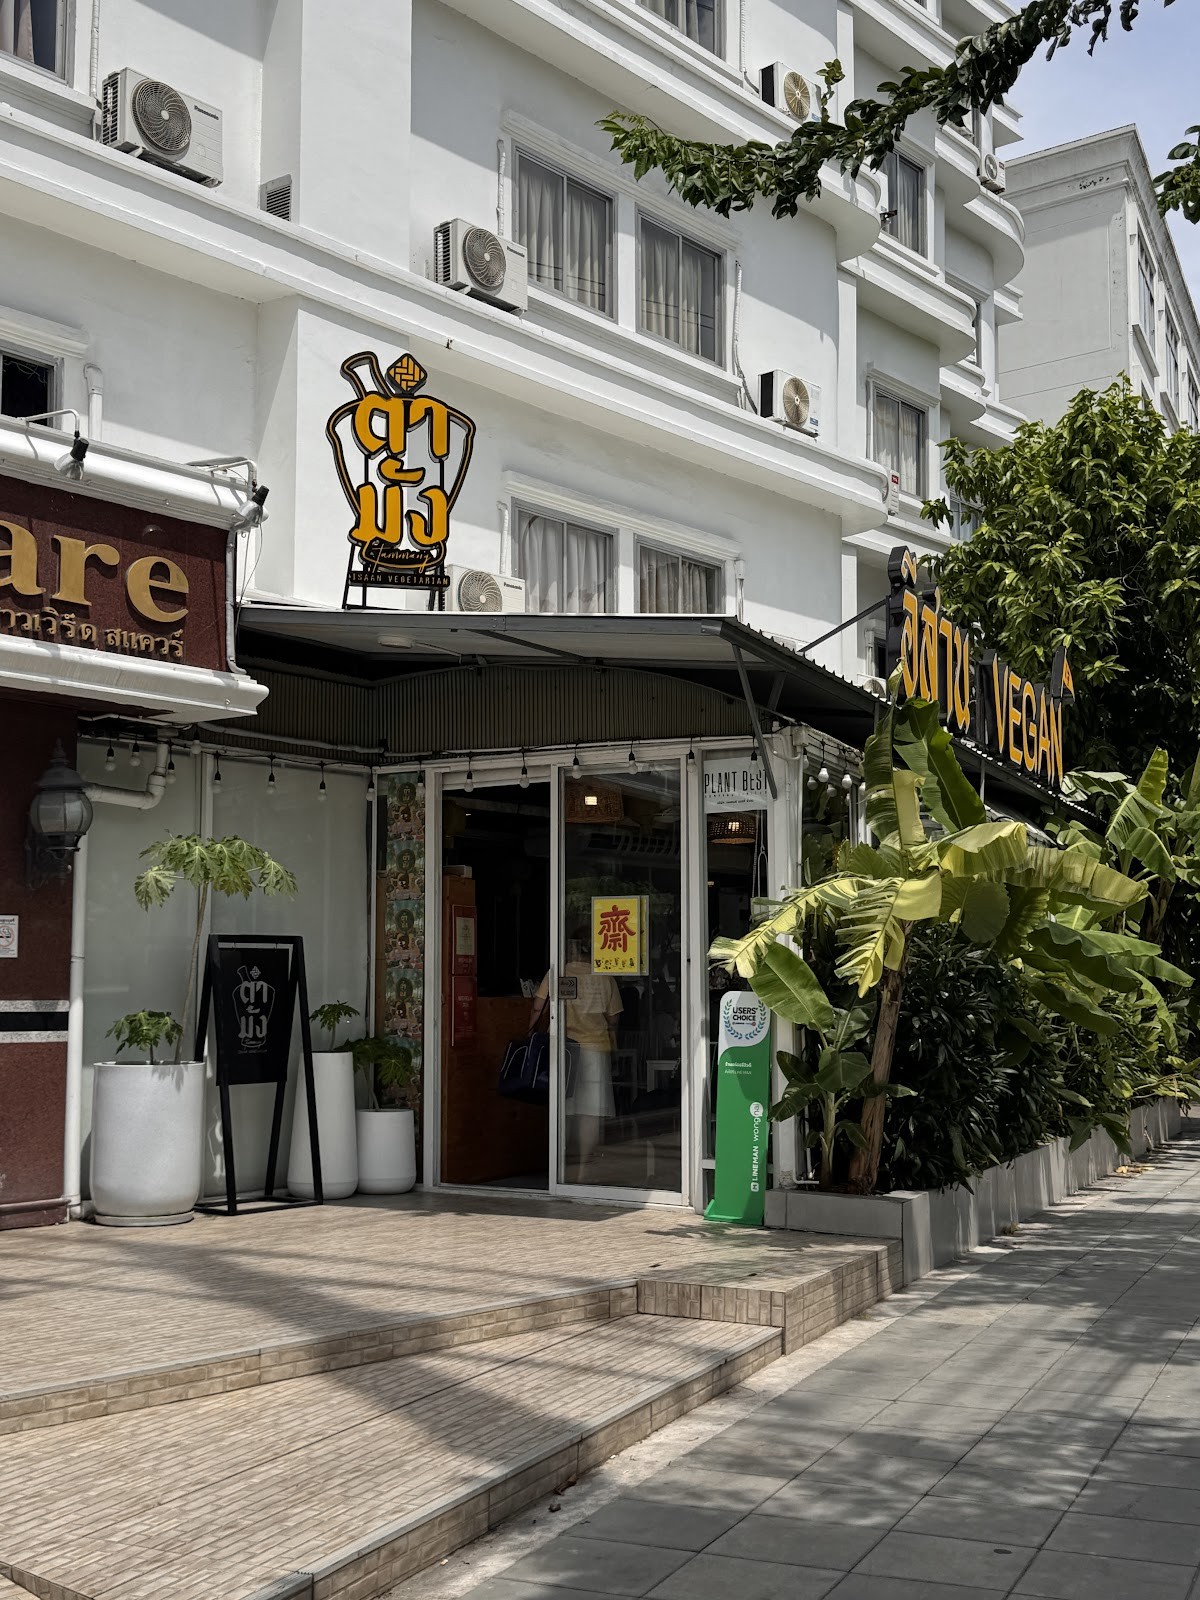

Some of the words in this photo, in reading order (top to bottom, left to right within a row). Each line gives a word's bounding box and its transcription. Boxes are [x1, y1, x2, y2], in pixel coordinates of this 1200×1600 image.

[371, 543, 432, 574] Tammang
[352, 573, 382, 582] ISAAN
[387, 574, 449, 586] VEGETARIAN
[105, 628, 184, 658] สแควร์
[991, 652, 1064, 786] VEGAN
[704, 771, 737, 794] PLANT
[732, 1014, 757, 1022] CHOICE
